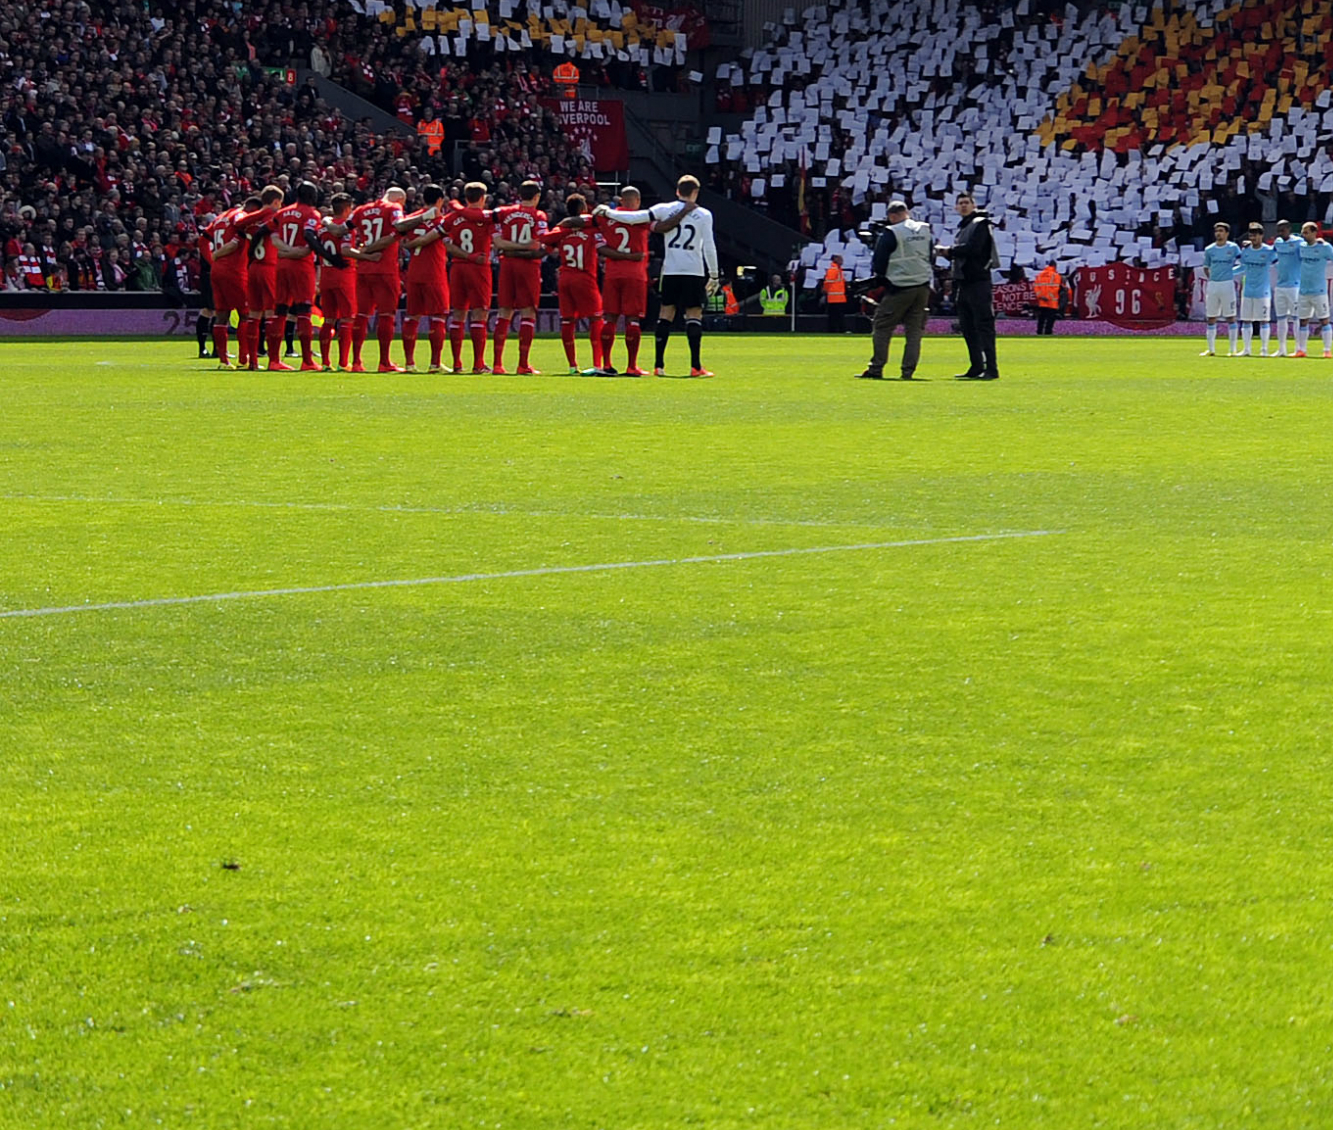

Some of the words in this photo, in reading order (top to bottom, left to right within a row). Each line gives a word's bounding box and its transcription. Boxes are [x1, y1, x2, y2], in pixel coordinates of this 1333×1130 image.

[560, 101, 576, 112] WE
[578, 101, 598, 112] ARE
[283, 223, 299, 248] 17
[361, 217, 384, 247] 37
[413, 228, 426, 256] 7
[459, 228, 474, 254] 8
[511, 223, 532, 246] 14
[614, 226, 631, 254] 2
[668, 224, 696, 251] 22
[563, 243, 584, 270] 31
[1002, 292, 1021, 302] NOT
[1023, 291, 1036, 301] BE
[1115, 289, 1142, 315] 96
